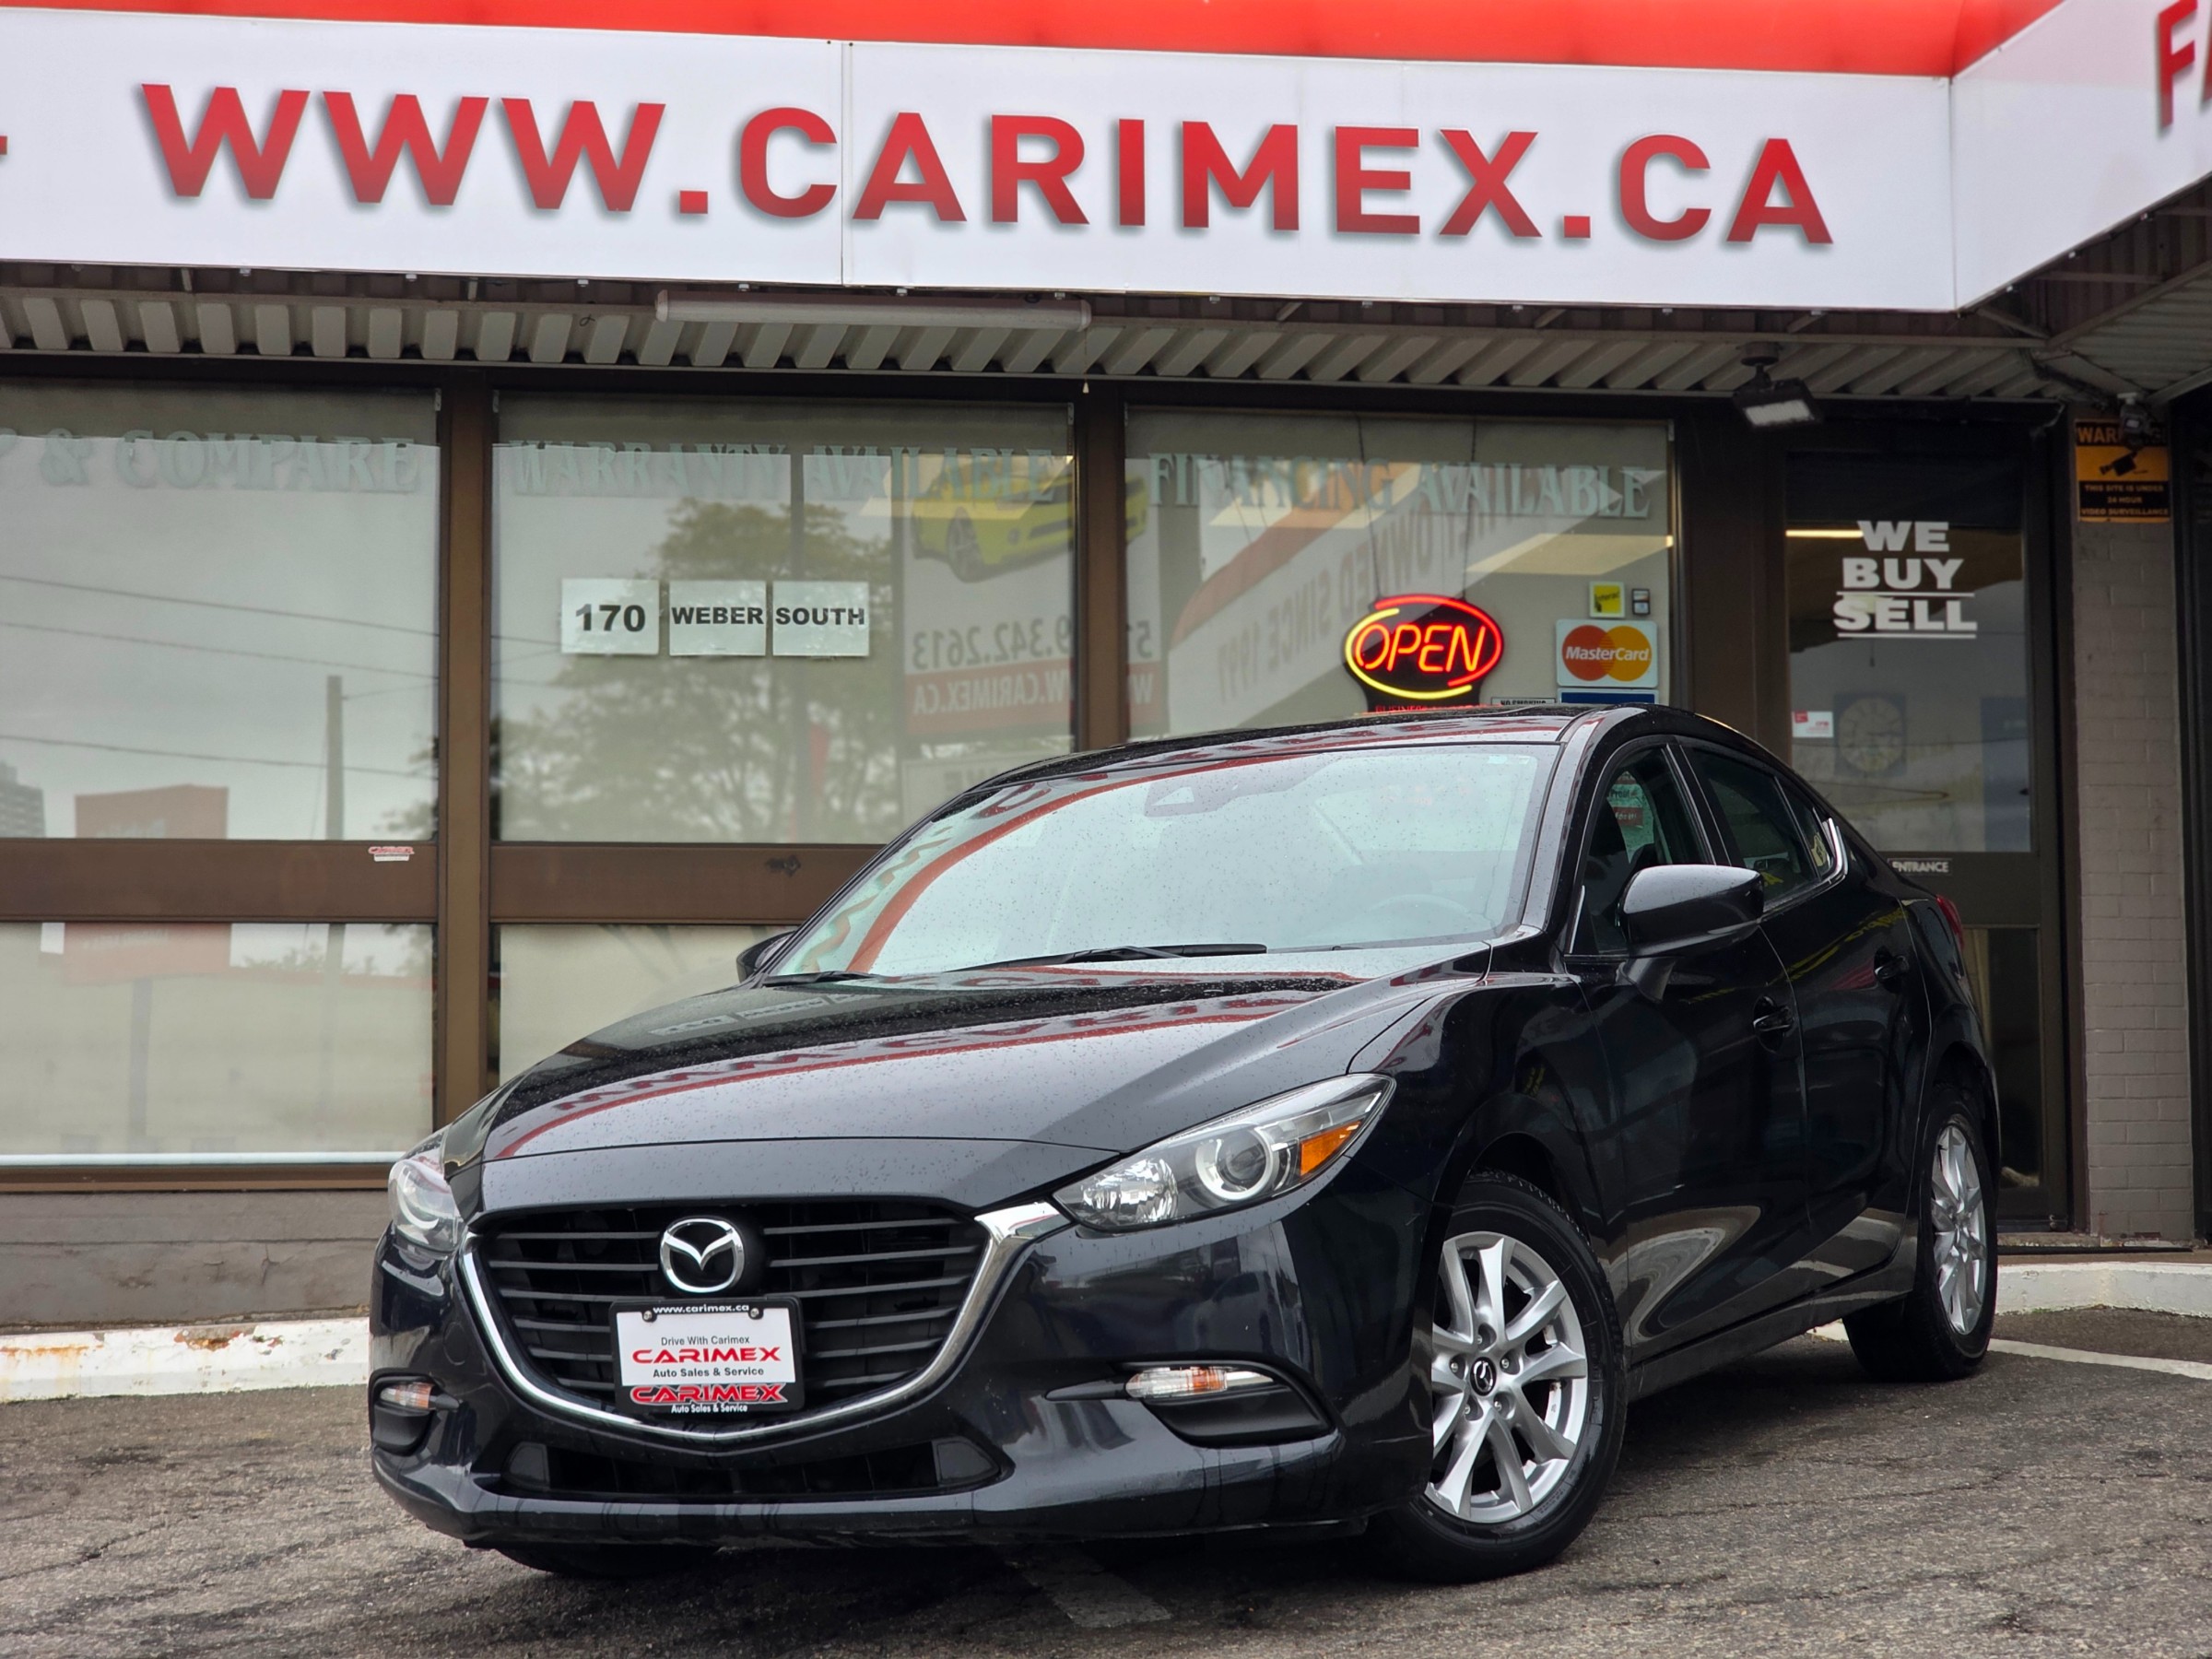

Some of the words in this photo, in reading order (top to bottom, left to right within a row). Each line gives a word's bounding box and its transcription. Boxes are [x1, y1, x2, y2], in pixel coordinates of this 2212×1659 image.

[2158, 0, 2212, 128] F
[140, 83, 1833, 244] WWW.CARIMEX.CA
[40, 428, 92, 487] &
[116, 429, 420, 493] COMPARE
[510, 440, 786, 497] WARRANTY
[809, 445, 1054, 501] AVAILABLE
[1418, 461, 1650, 518] AVAILABLE
[2108, 508, 2169, 516] SURVEILLANCE
[1856, 520, 1949, 552] WE
[1842, 558, 1964, 590] BUY
[575, 603, 646, 632] 170
[671, 606, 764, 625] WEBER
[775, 606, 865, 626] SOUTH
[1833, 597, 1978, 631] SELL
[1354, 623, 1487, 673] OPEN
[1565, 645, 1650, 662] MasterCard
[653, 1304, 749, 1313] www.carimex.ca
[632, 1347, 781, 1363] CARIMEX
[661, 1336, 685, 1346] Drive
[687, 1335, 709, 1346] With
[711, 1335, 750, 1345] Carimex
[653, 1369, 677, 1378] Auto
[680, 1368, 710, 1377] Sales
[713, 1368, 721, 1376] &
[724, 1367, 764, 1376] Service
[631, 1384, 783, 1404] CARIMEX
[671, 1404, 690, 1414] Auto
[691, 1404, 712, 1413] Sales
[713, 1404, 719, 1412] &
[721, 1403, 748, 1412] Service
